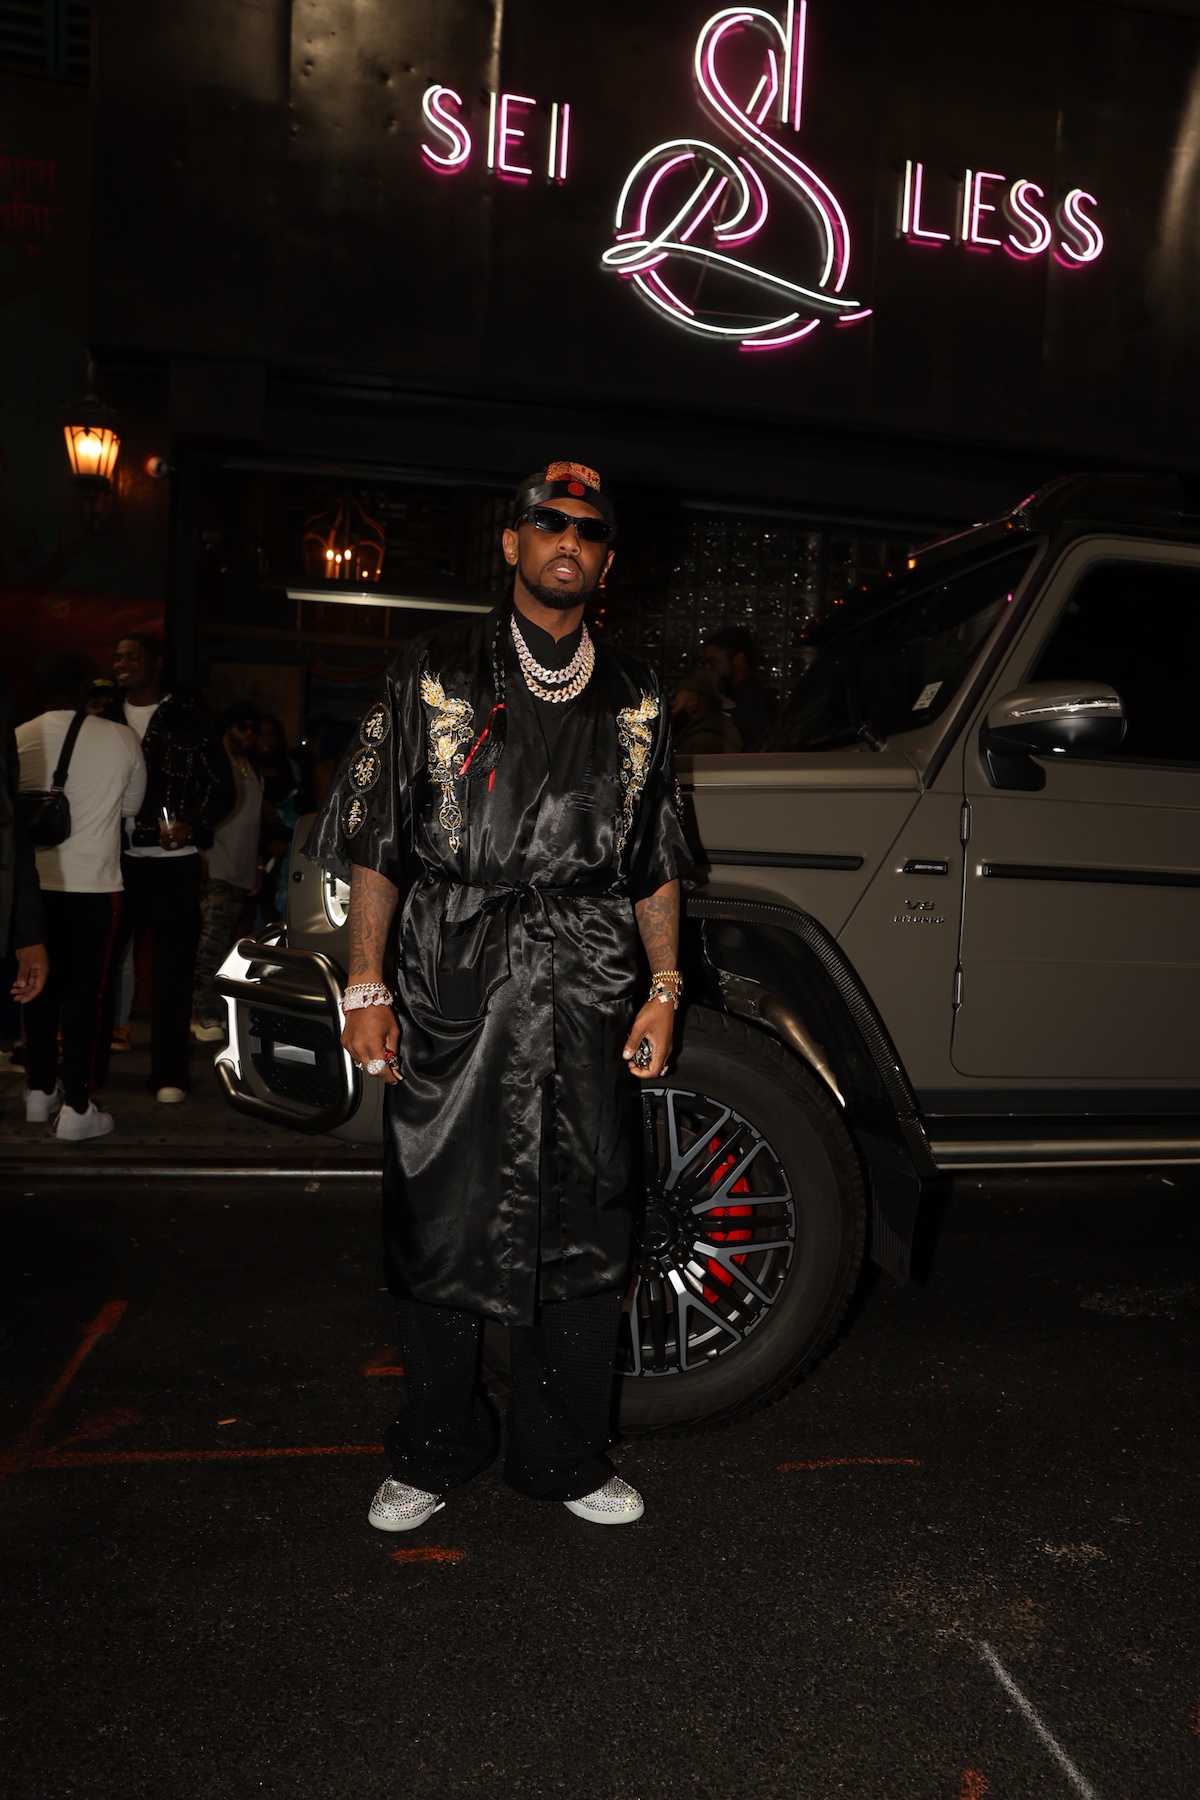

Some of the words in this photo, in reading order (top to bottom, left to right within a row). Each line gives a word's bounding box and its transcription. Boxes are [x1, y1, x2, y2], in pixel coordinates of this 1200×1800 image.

[421, 84, 570, 179] SEI
[902, 159, 1104, 263] LESS
[904, 900, 935, 911] V8
